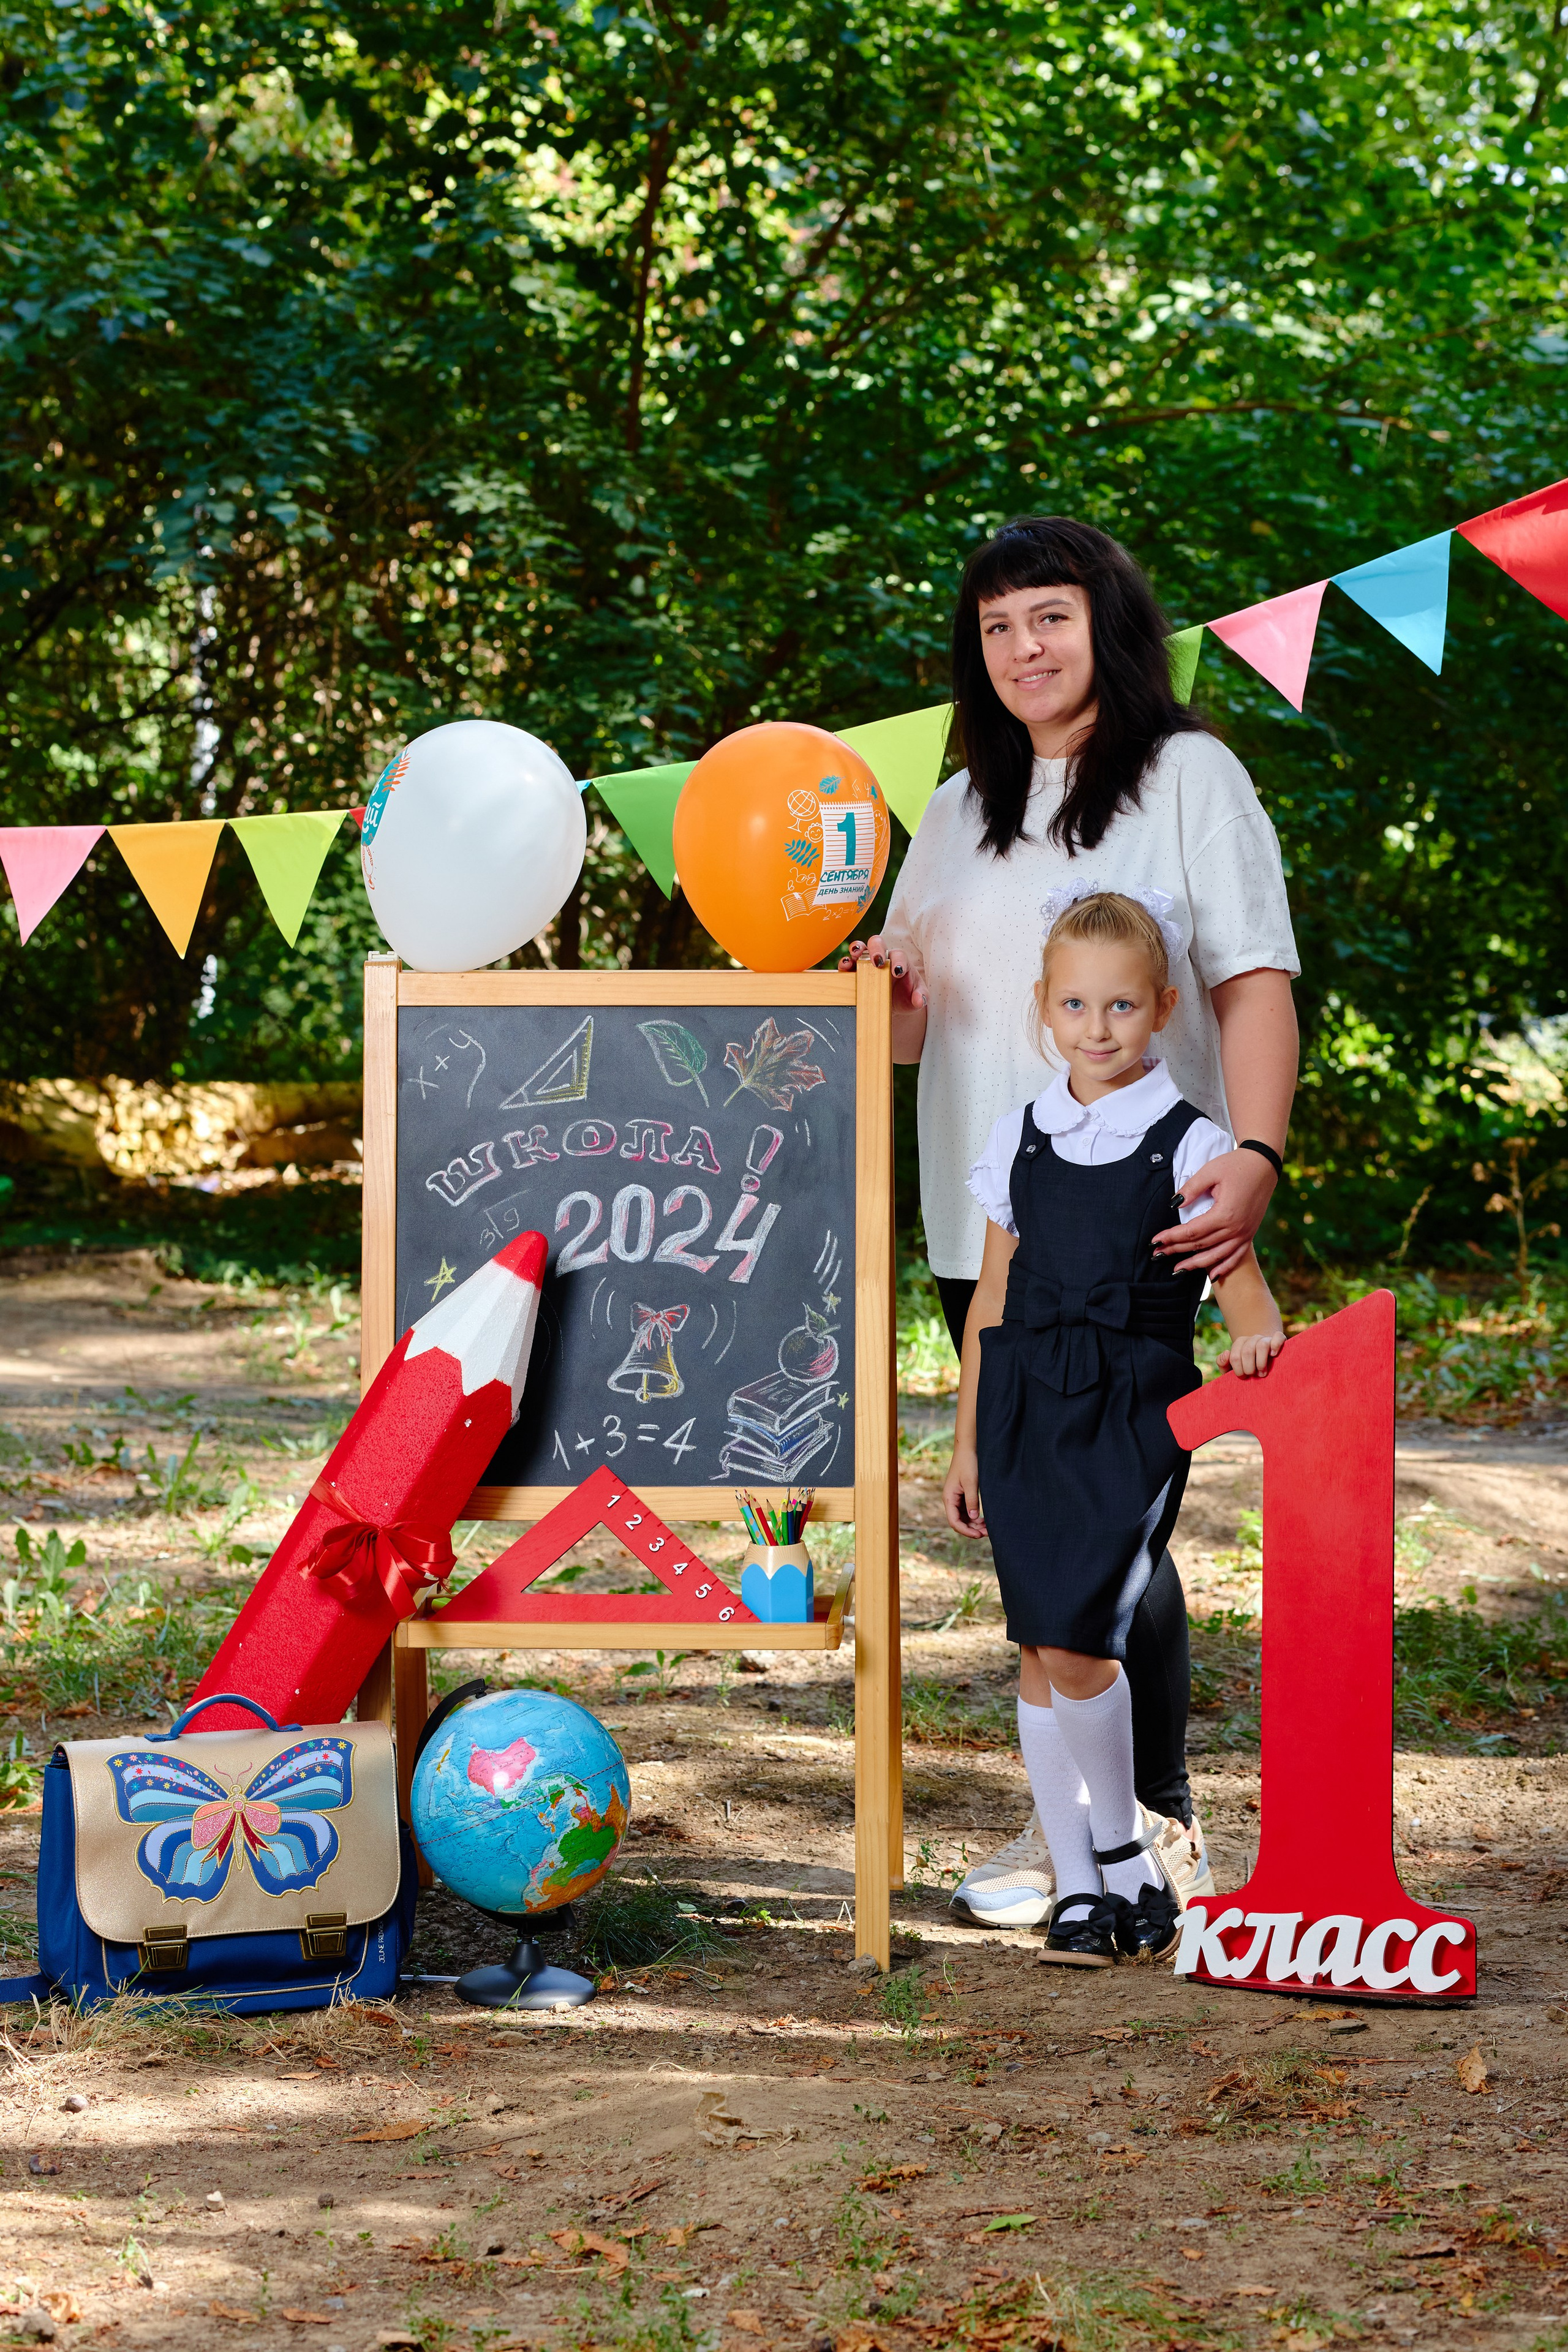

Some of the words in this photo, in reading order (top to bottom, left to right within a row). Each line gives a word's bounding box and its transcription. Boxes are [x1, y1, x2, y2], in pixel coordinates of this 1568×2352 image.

[837, 812, 856, 866] 1
[817, 887, 838, 897] ДЕНЬ
[839, 885, 864, 894] ЗНАНИЙ
[820, 869, 869, 883] СЕНТЯБРЯ
[554, 1183, 782, 1284] 2024
[607, 1494, 620, 1508] 1
[625, 1513, 643, 1530] 2
[649, 1537, 665, 1552] 3
[673, 1562, 688, 1575] 4
[695, 1583, 712, 1599] 5
[718, 1607, 735, 1621] 6
